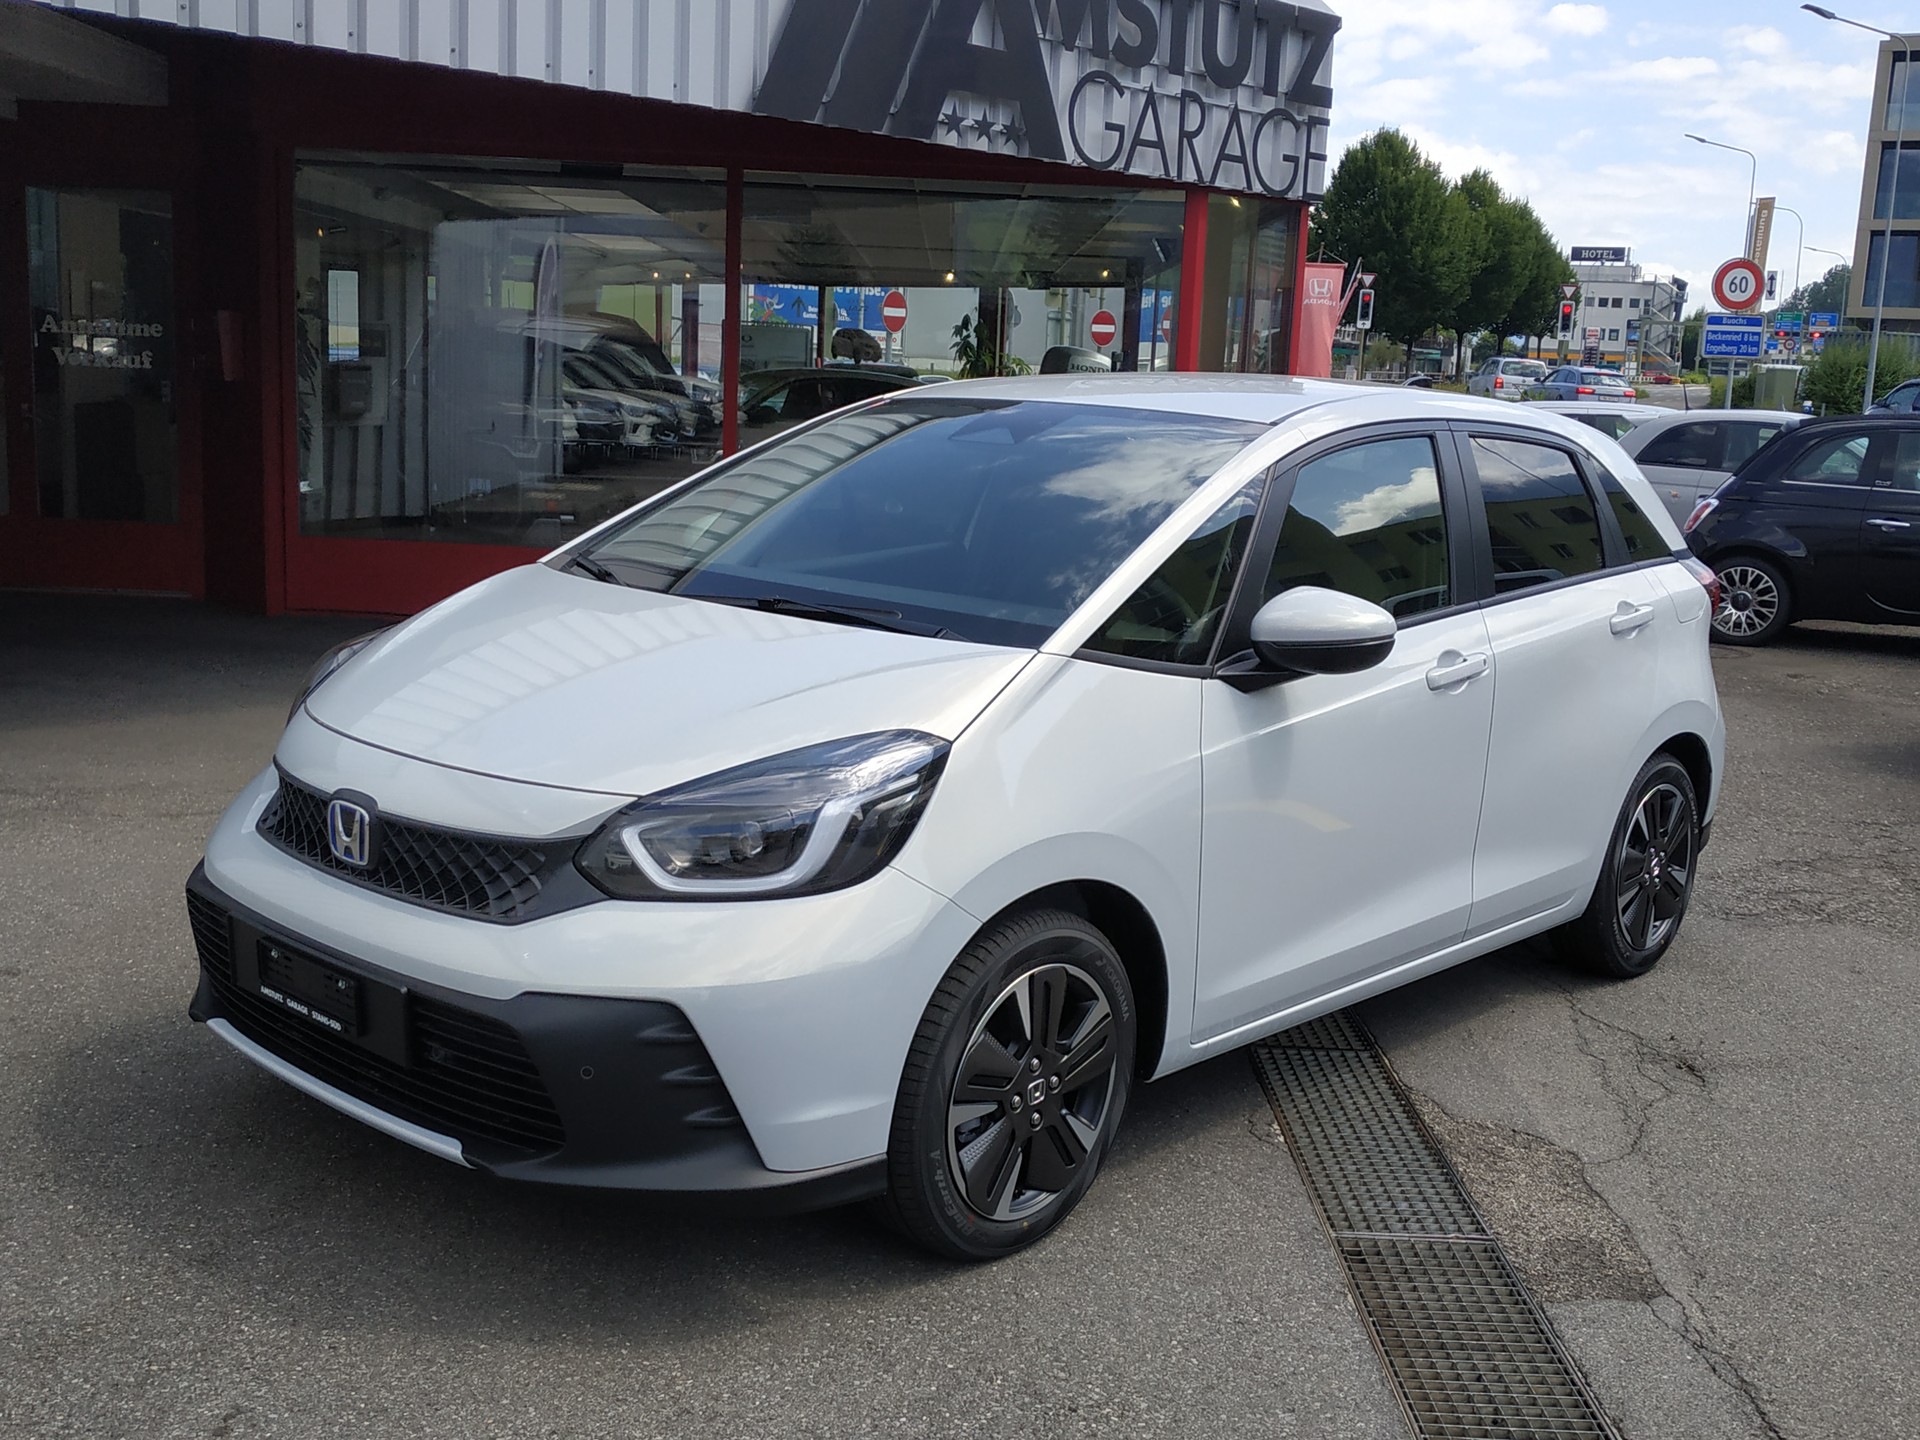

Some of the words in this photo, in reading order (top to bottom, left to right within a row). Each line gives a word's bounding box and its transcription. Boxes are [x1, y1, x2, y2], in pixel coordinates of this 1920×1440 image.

[1068, 70, 1331, 200] GARAGE
[1581, 249, 1615, 259] HOTEL
[1728, 275, 1749, 294] 60
[1722, 317, 1747, 325] Buochs
[1707, 332, 1743, 341] Beckenried
[1743, 333, 1749, 341] 8
[1749, 333, 1759, 341] km
[1706, 343, 1738, 354] Engelberg
[1739, 345, 1748, 353] 20
[1748, 345, 1758, 353] km
[52, 347, 154, 369] Verkauf
